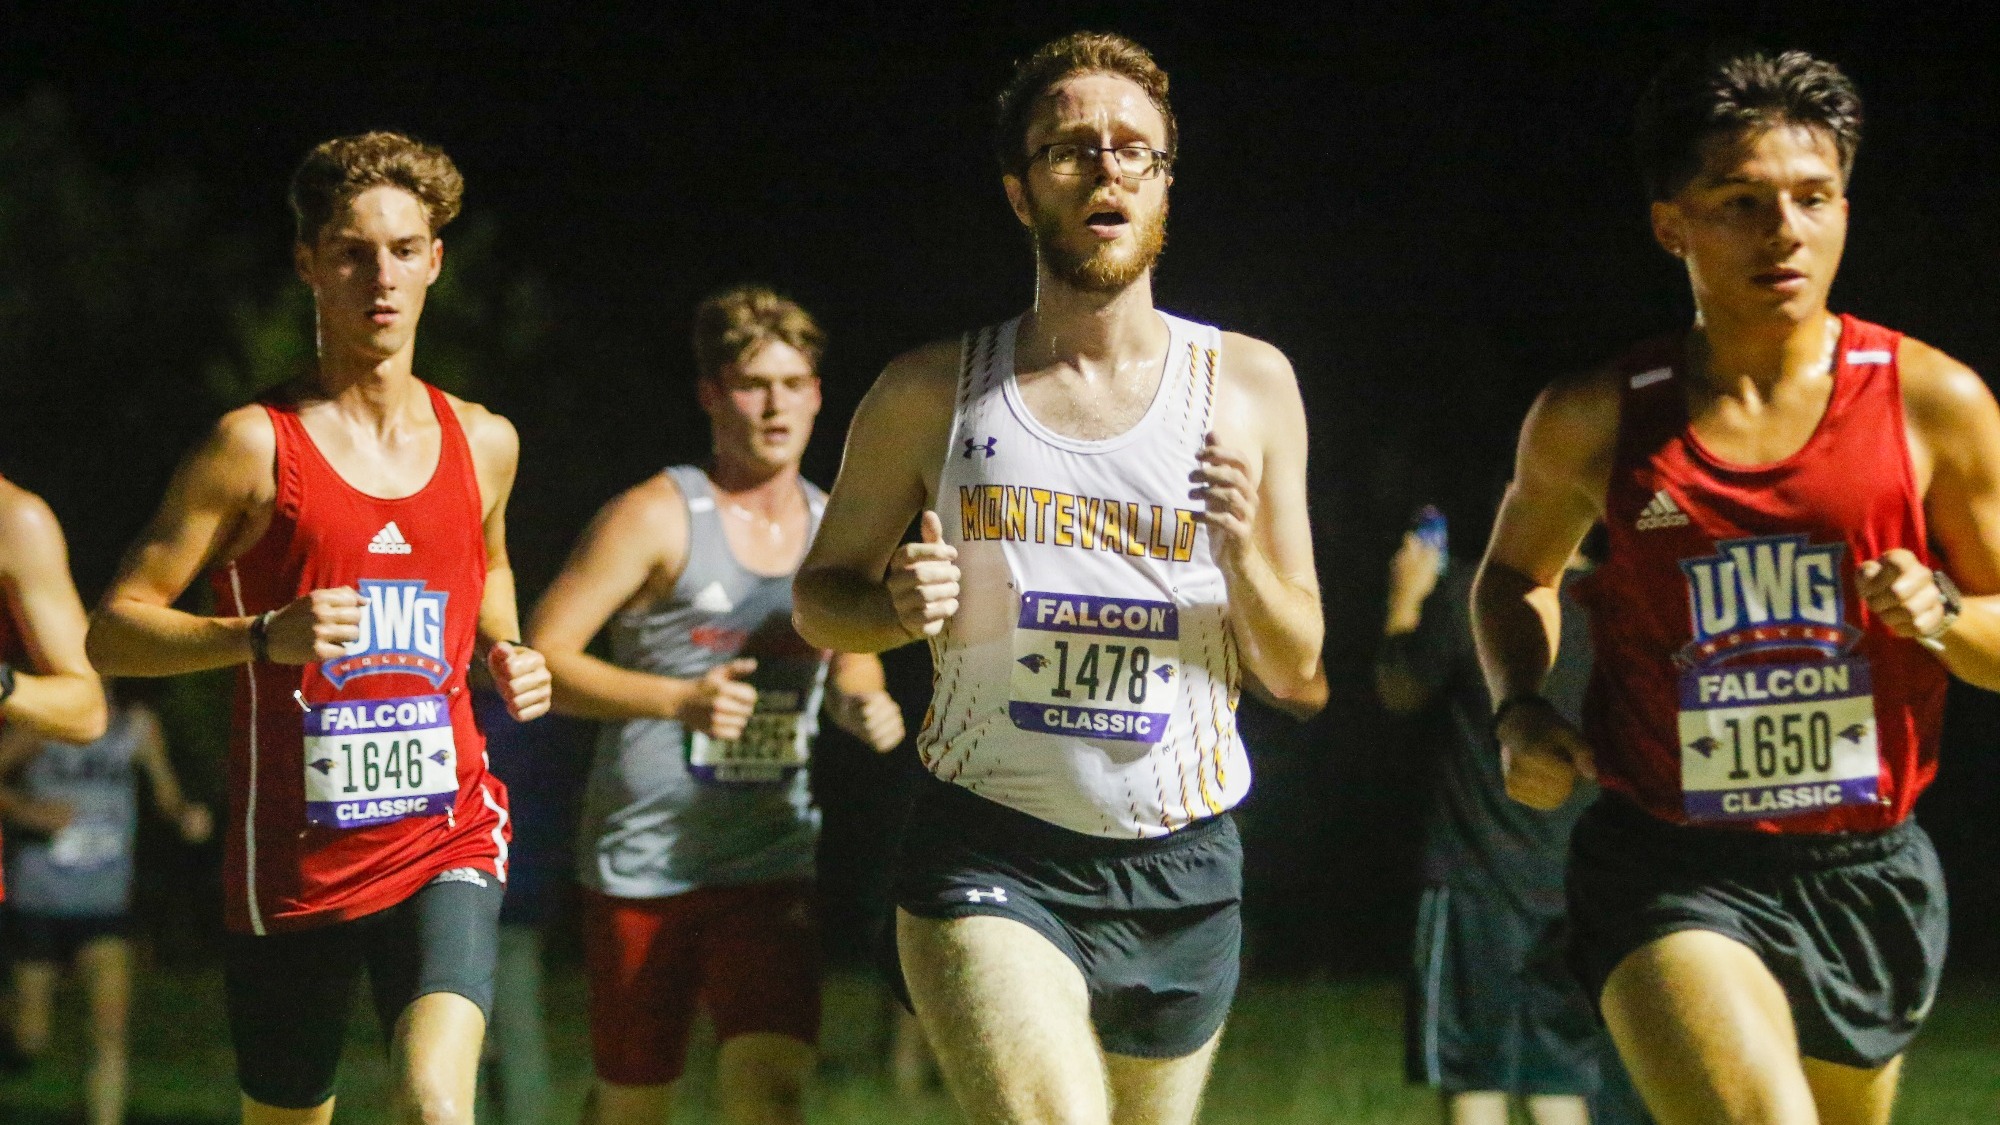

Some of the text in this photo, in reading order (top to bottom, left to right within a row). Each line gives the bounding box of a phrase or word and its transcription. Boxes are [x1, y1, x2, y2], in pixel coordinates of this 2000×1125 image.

[959, 485, 1197, 562] MONTEVALLO
[1694, 542, 1838, 636] UWG
[1036, 599, 1167, 633] FALCON
[1051, 640, 1150, 705] 1478
[1698, 664, 1850, 704] FALCON
[321, 700, 439, 731] FALCON
[1043, 708, 1151, 735] CLASSIC
[341, 738, 424, 794] 1646
[1724, 711, 1833, 781] 1650
[336, 797, 429, 822] CLASSIC
[1722, 784, 1843, 815] CLASSIC
